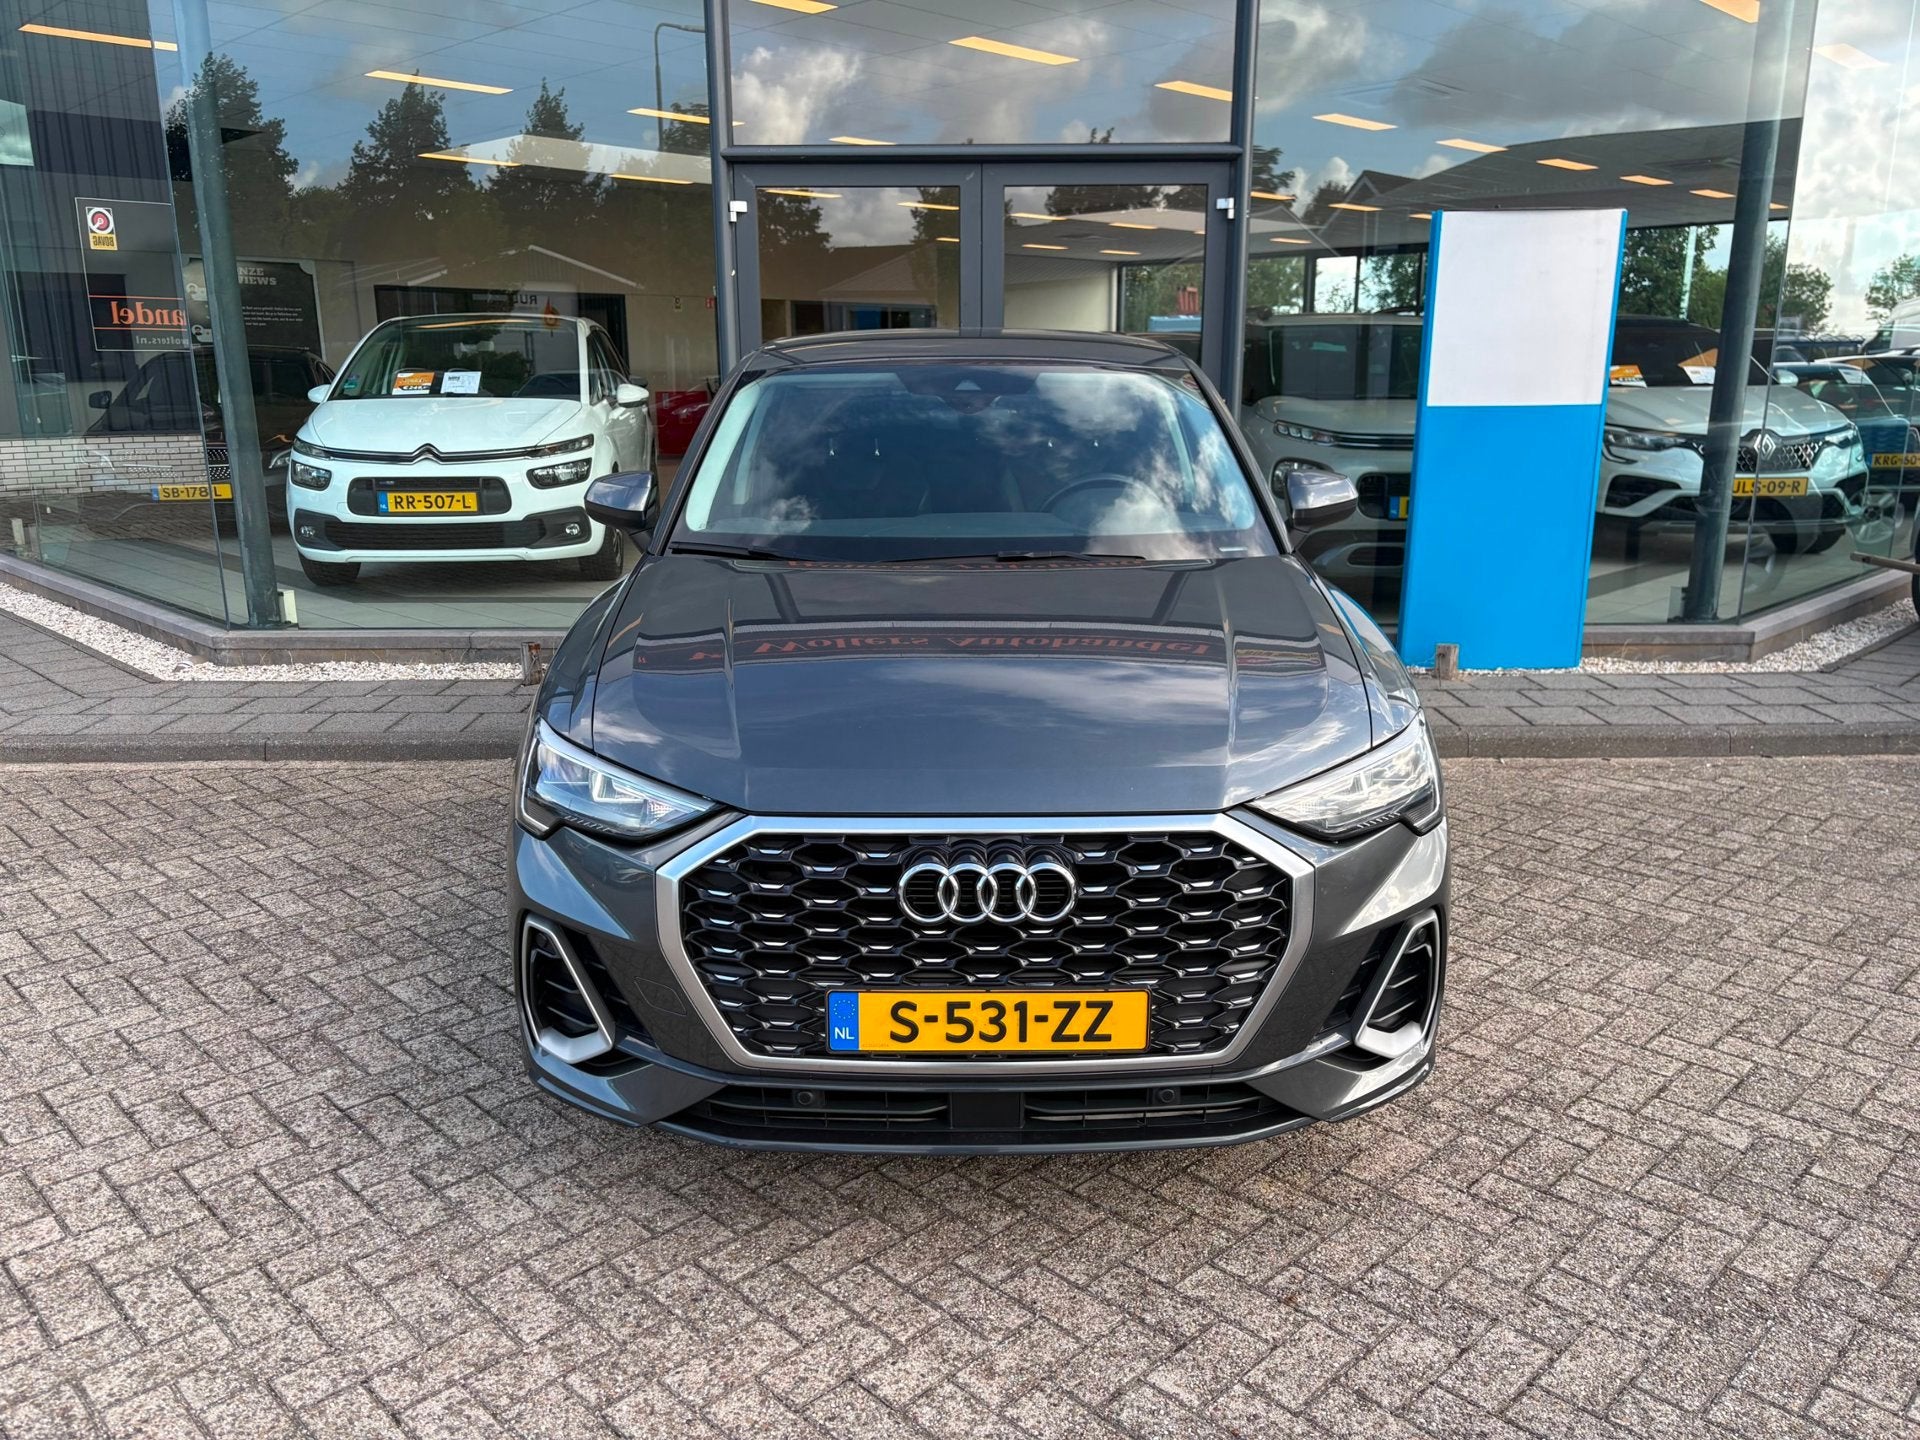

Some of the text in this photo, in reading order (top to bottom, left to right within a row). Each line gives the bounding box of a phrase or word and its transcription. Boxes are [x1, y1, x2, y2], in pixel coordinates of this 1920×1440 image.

[239, 267, 265, 276] NZE
[238, 276, 277, 286] VIEWS
[162, 486, 222, 498] SB-178L
[394, 494, 471, 510] RR-507-L
[889, 1000, 1114, 1044] S-531-ZZ
[834, 1027, 855, 1040] NL
